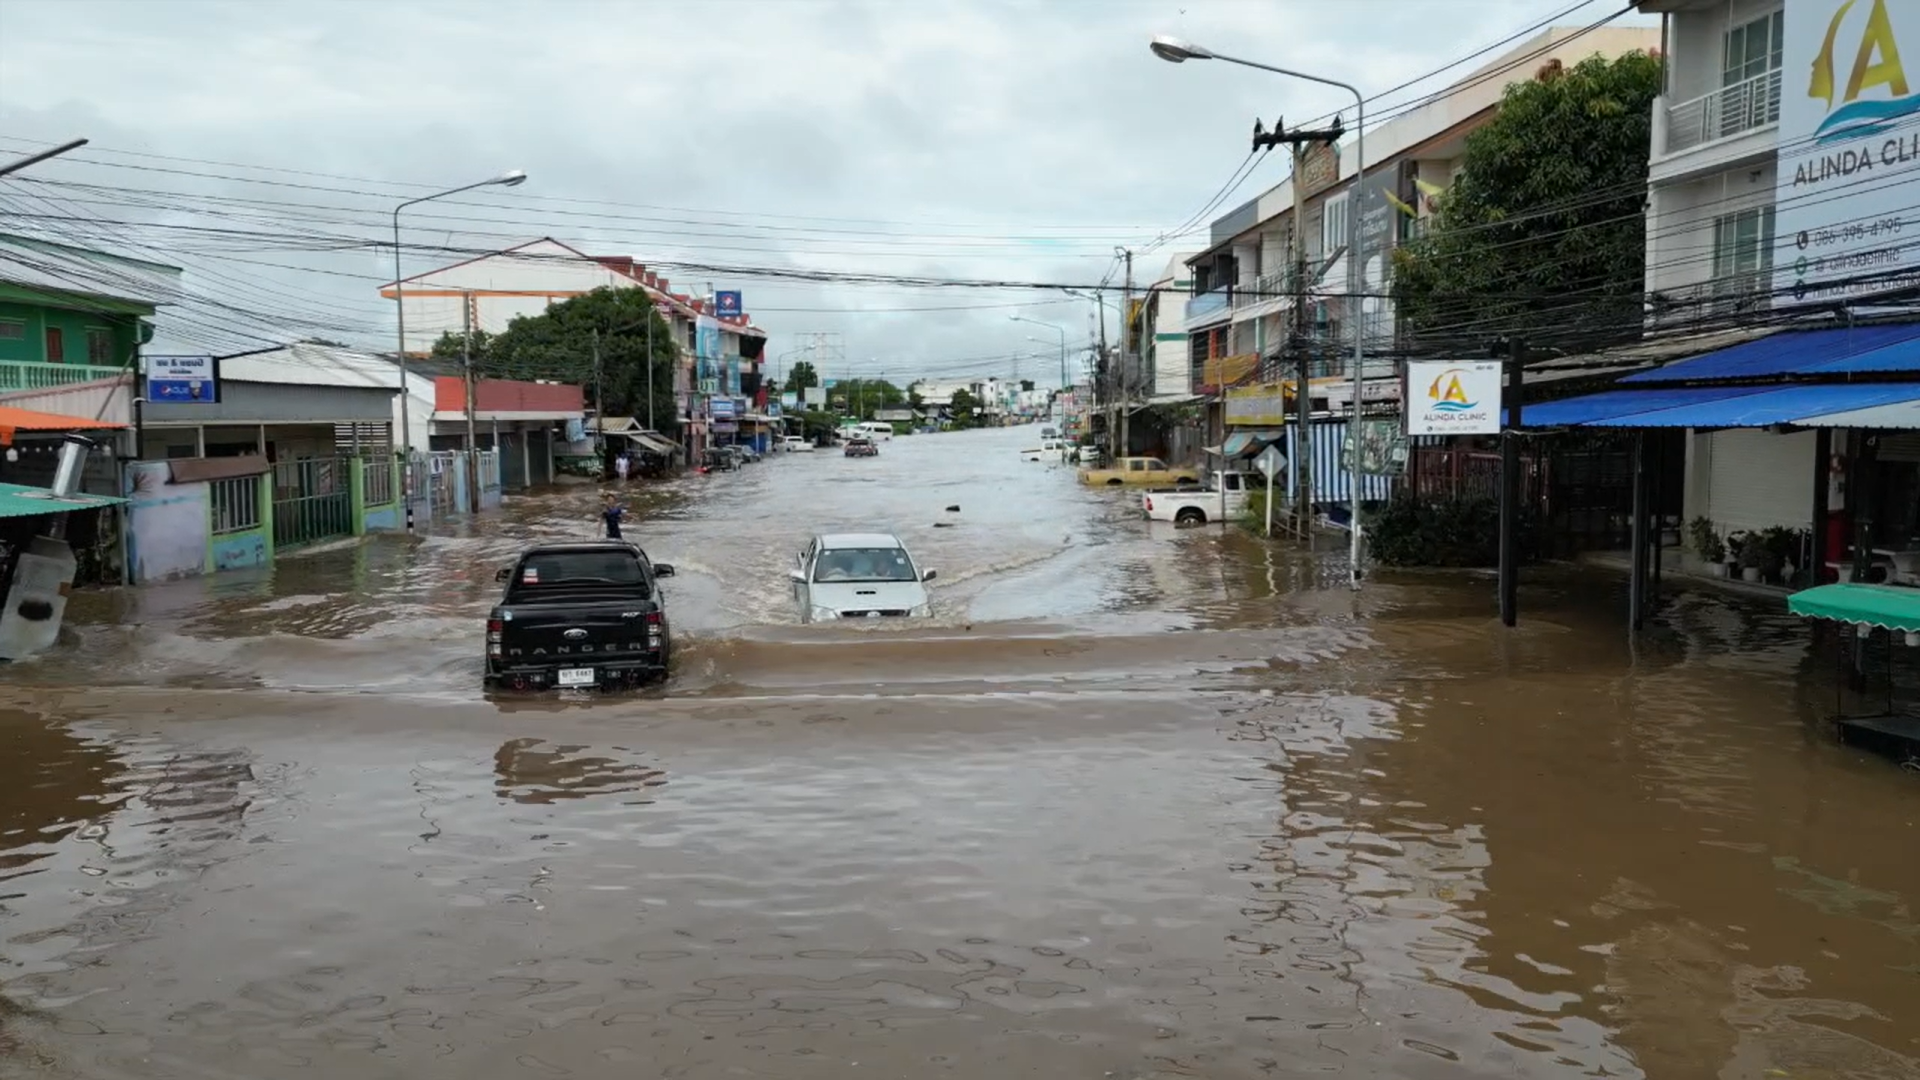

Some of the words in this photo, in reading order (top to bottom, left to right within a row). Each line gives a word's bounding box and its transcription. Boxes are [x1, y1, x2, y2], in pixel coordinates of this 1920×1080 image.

[1793, 146, 1872, 187] ALINDA
[1814, 217, 1902, 247] 086-395-4795
[1423, 413, 1456, 421] ALINDA
[1457, 412, 1487, 421] CLINIC
[509, 642, 641, 657] RANGER
